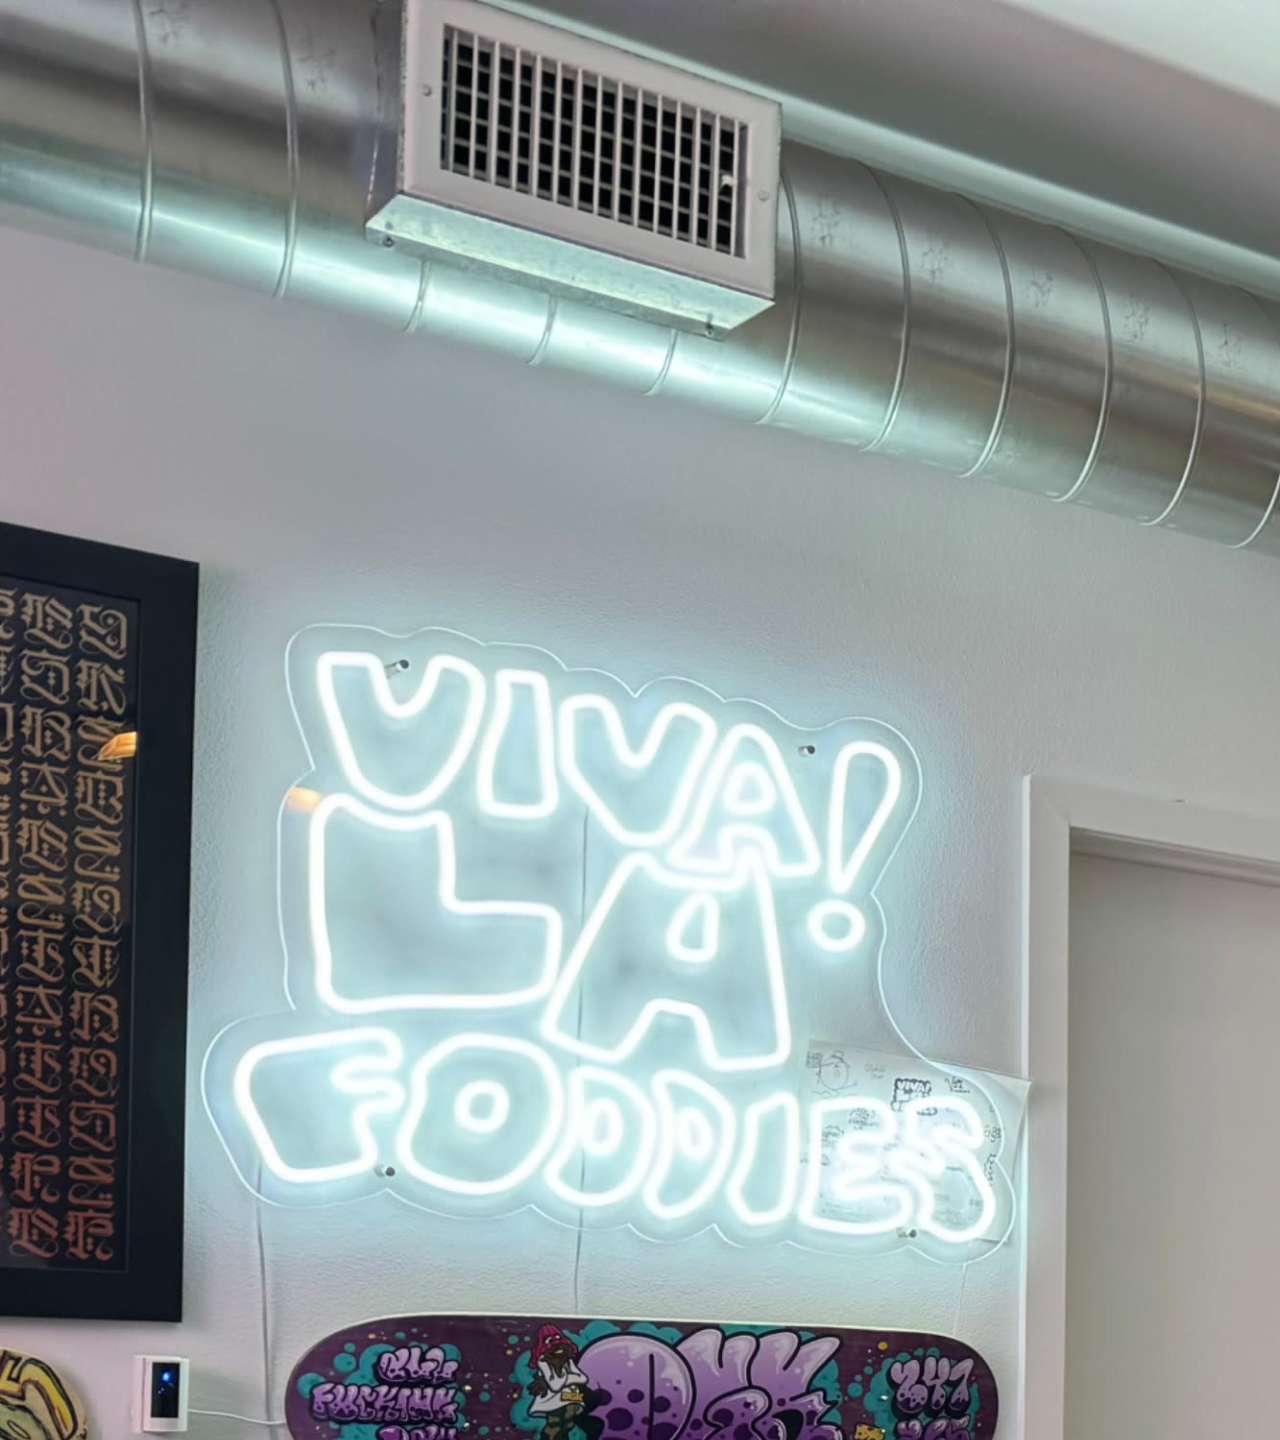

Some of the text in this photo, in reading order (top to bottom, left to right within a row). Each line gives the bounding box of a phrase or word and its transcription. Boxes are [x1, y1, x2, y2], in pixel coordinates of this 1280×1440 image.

[308, 793, 793, 1071] LA
[317, 651, 903, 952] VIVA!
[233, 1027, 997, 1243] FOODIES
